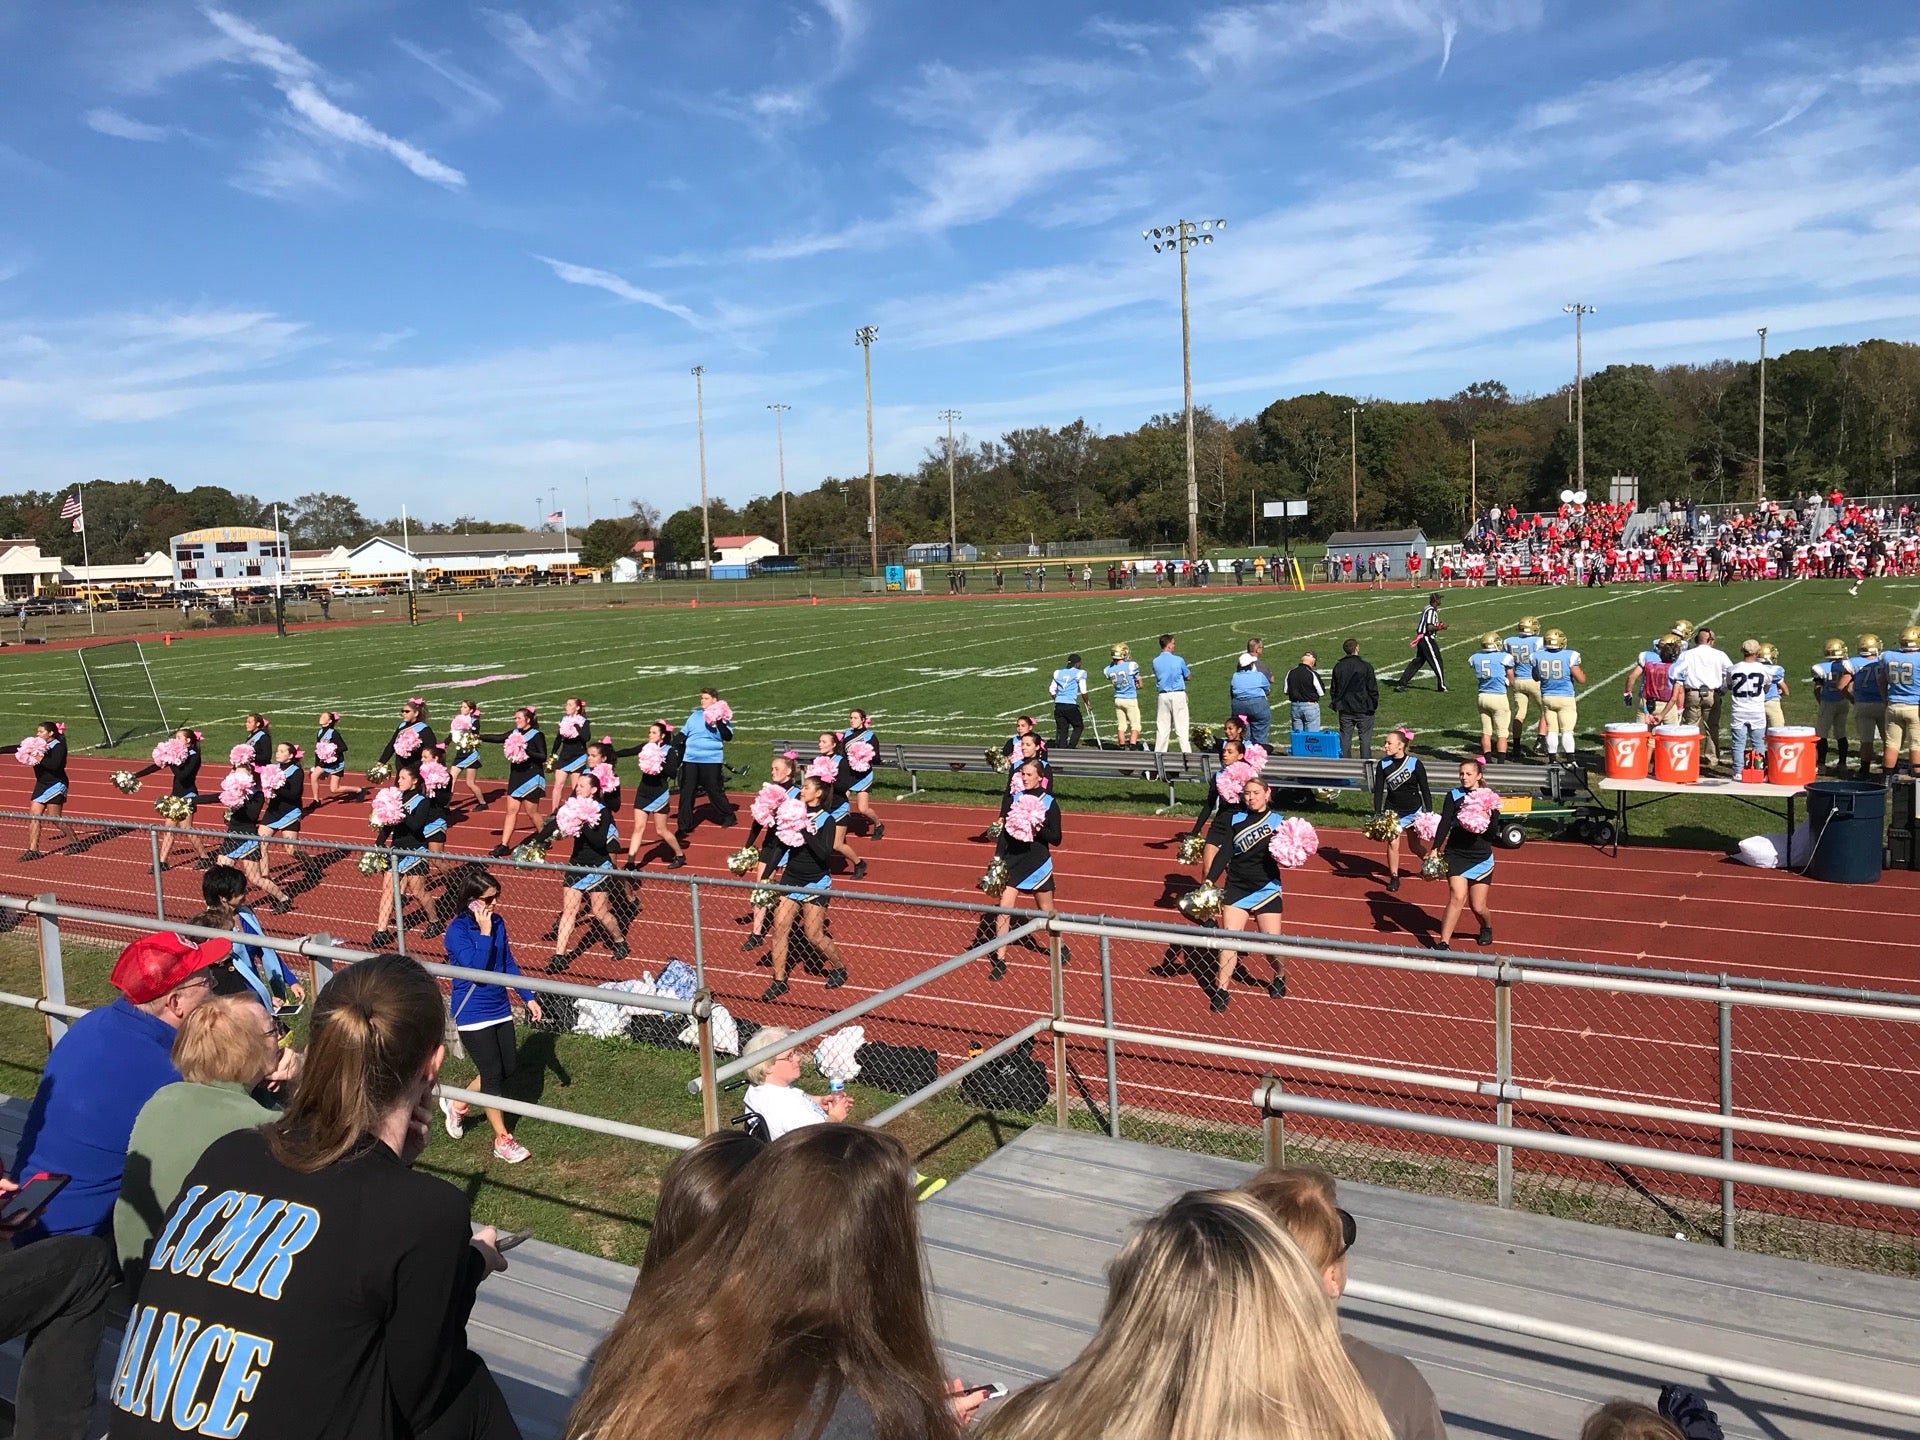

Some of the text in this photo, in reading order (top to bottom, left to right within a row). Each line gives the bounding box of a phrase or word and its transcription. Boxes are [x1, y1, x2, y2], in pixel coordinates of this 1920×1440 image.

[183, 528, 224, 542] LCMR
[179, 581, 199, 589] NIA
[1511, 644, 1530, 664] 52
[1481, 659, 1491, 679] 5
[1540, 659, 1563, 680] 99
[1888, 661, 1914, 685] 62
[1062, 675, 1071, 690] 7
[1109, 670, 1129, 688] 23
[1731, 672, 1765, 698] 23
[1617, 740, 1633, 754] G
[1672, 743, 1688, 757] G
[1779, 744, 1795, 759] G
[1238, 823, 1272, 852] TIGERS
[148, 1185, 320, 1300] LCMR
